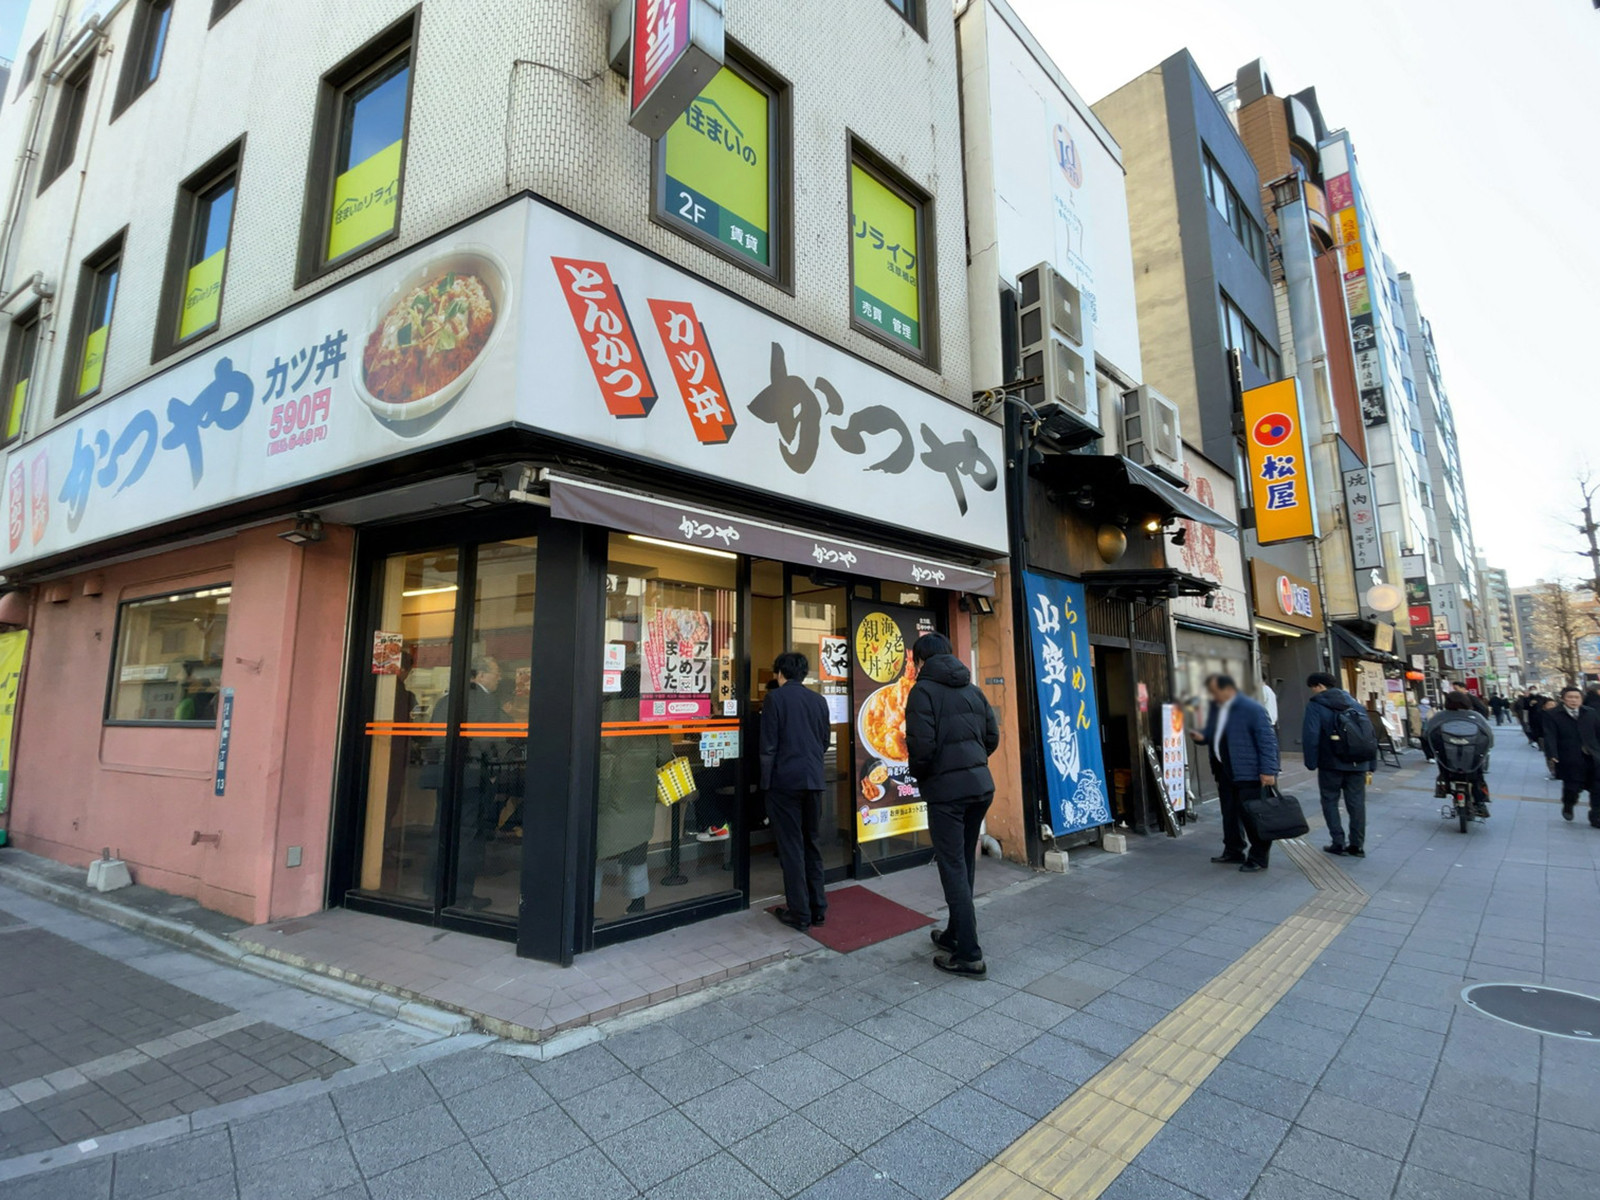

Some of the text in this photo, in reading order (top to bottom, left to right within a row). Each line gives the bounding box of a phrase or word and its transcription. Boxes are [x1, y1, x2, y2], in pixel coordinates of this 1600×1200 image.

[685, 104, 757, 166] 住まいの
[679, 191, 706, 223] 2F
[730, 225, 758, 254] 賃貸
[852, 214, 916, 270] リライフ
[564, 264, 642, 398] とんかつ
[862, 300, 882, 325] 売買
[892, 317, 911, 340] 管理
[262, 329, 348, 405] カツ丼
[664, 310, 726, 424] カツ丼
[269, 387, 331, 438] 590円
[747, 341, 997, 517] かつや
[58, 356, 253, 534] かつや
[1261, 454, 1299, 510] 松屋
[1347, 473, 1368, 505] 焼肉
[679, 514, 740, 545] かつや
[813, 543, 857, 567] かつや
[912, 563, 946, 585] かつや
[693, 641, 708, 693] アプリ
[822, 640, 849, 675] かつや
[862, 618, 881, 677] 親子丼
[1065, 595, 1091, 730] らーめん
[216, 778, 224, 790] 13
